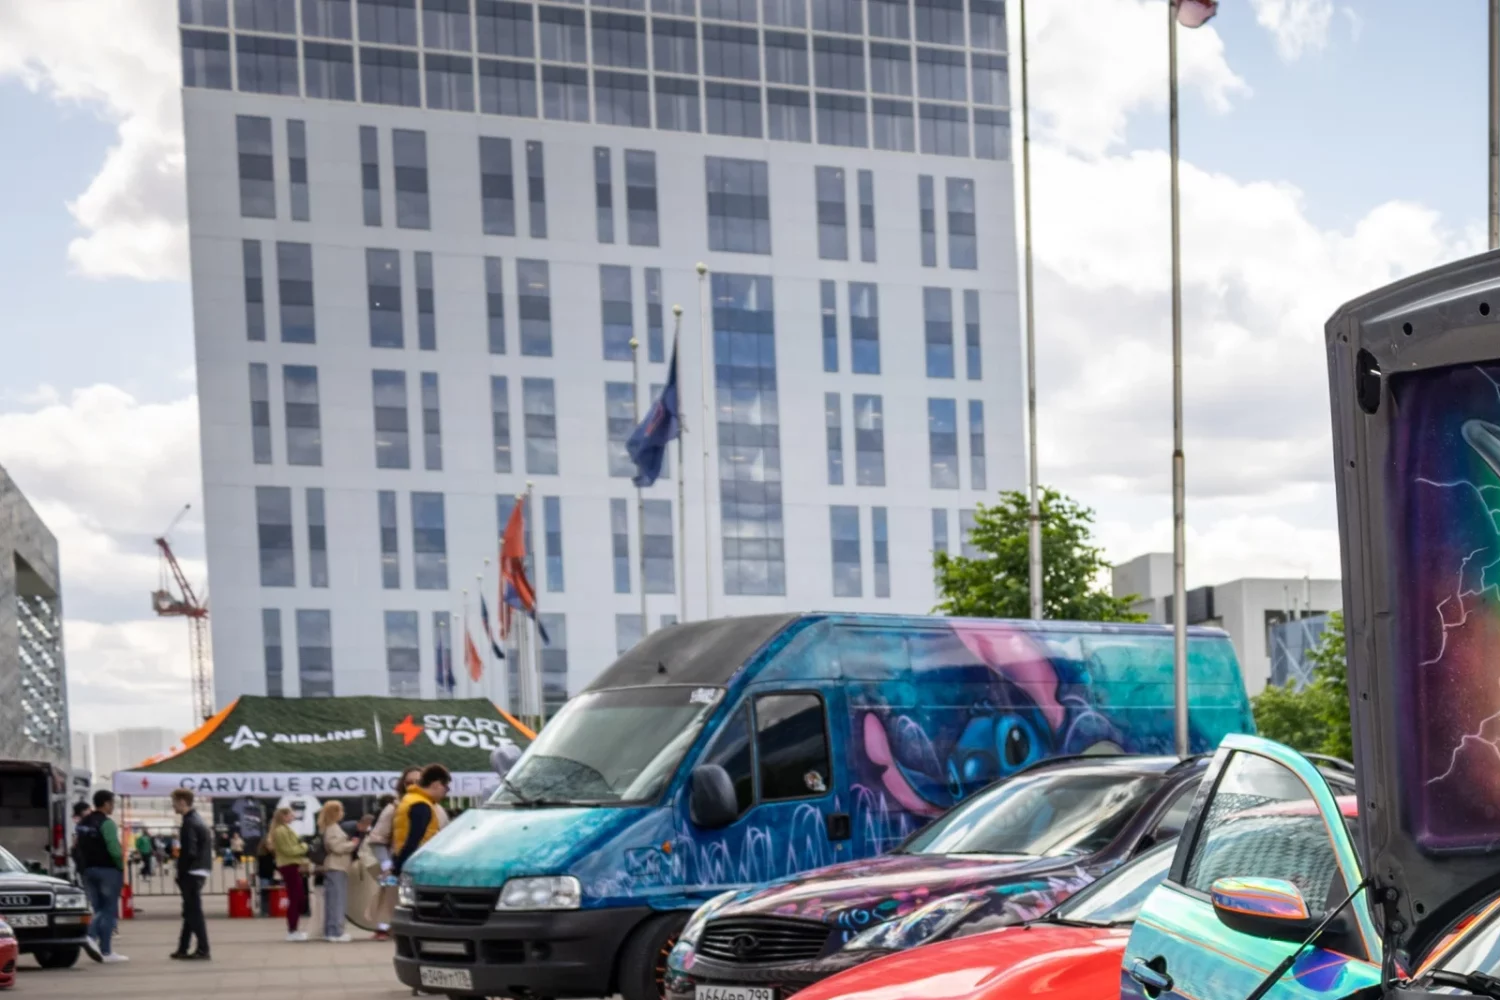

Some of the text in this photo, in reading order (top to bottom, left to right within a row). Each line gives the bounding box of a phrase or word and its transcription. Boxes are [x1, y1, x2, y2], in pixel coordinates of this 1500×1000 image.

[423, 714, 509, 736] START
[272, 728, 367, 743] AIRLINE
[424, 729, 513, 751] VOLT
[179, 777, 300, 792] CARVILLE
